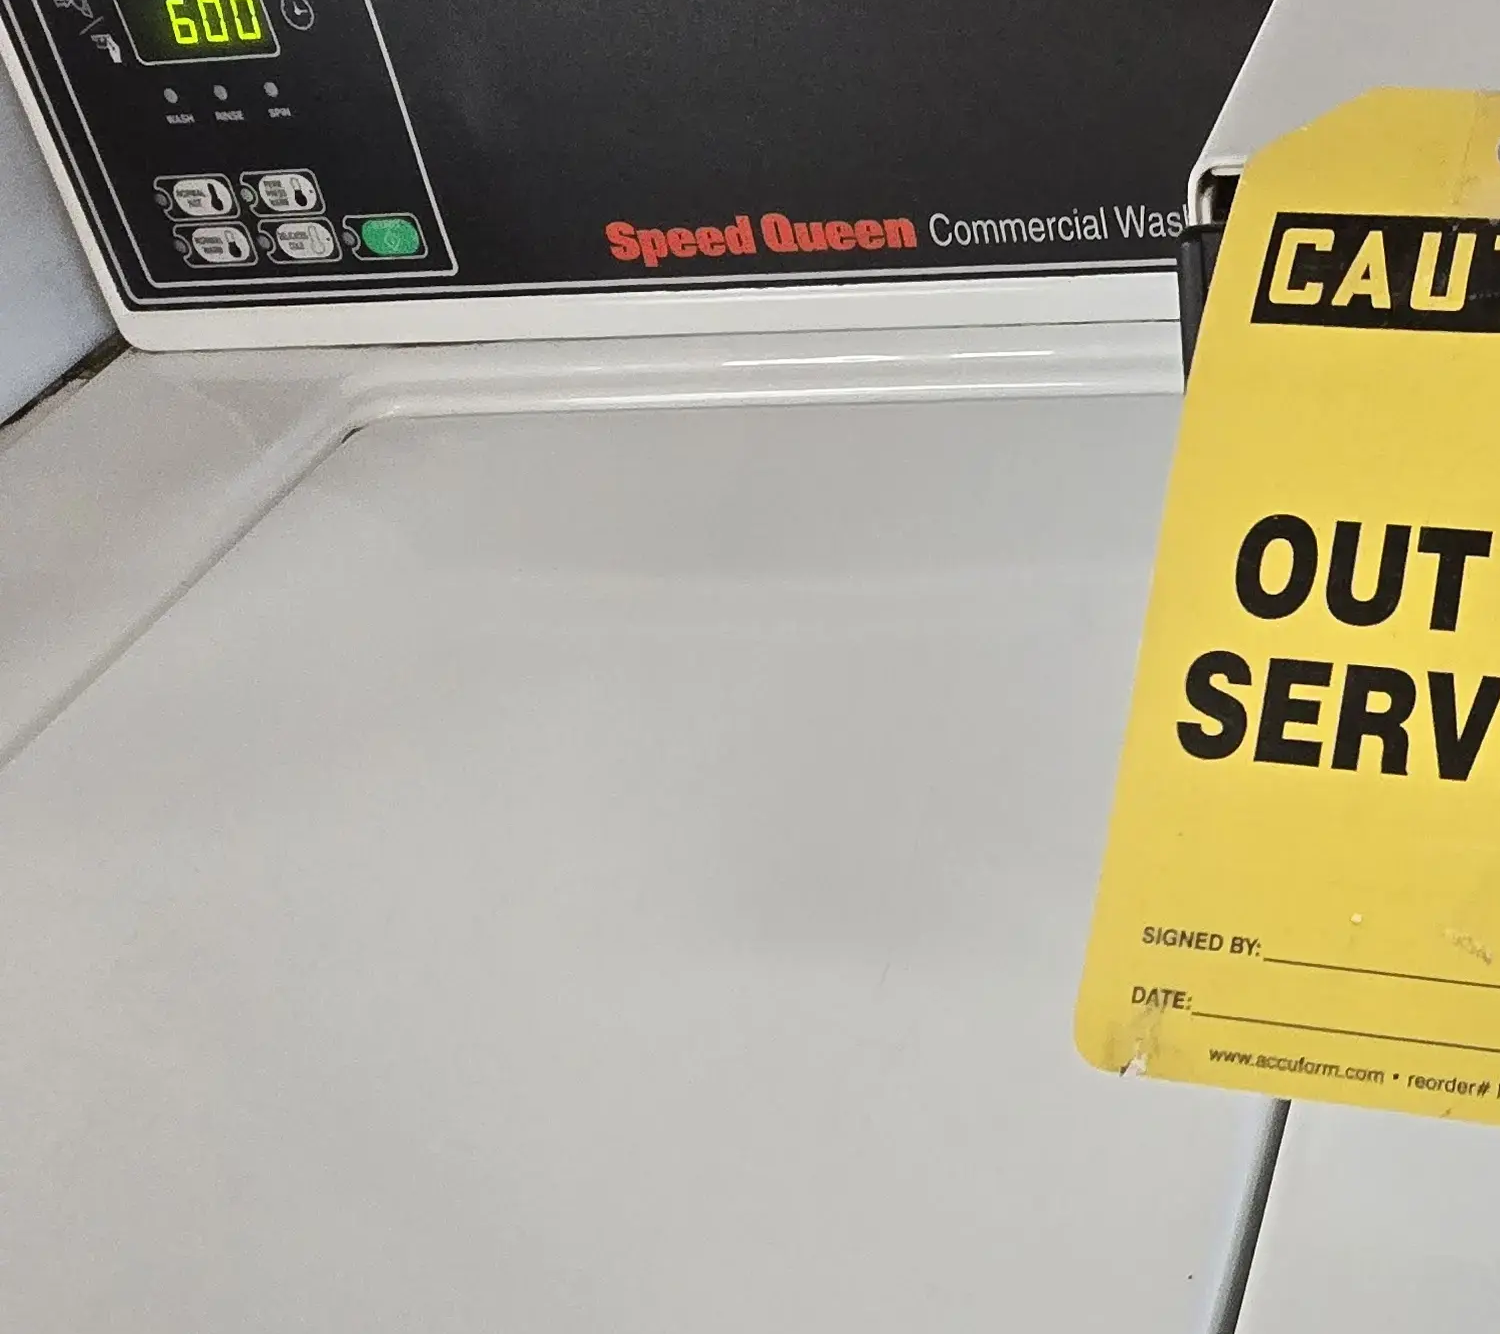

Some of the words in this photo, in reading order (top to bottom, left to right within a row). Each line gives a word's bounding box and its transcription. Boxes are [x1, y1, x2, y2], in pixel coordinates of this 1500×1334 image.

[605, 215, 757, 268] Speed
[760, 212, 918, 253] Queen
[929, 206, 1109, 247] Commercial
[1234, 514, 1493, 633] OUT
[1142, 926, 1224, 952] SIGNED
[1229, 936, 1261, 957] BY:
[1131, 986, 1192, 1011] DATE:
[1208, 1048, 1385, 1084] www.accuform.com
[1407, 1074, 1490, 1098] reorder#
